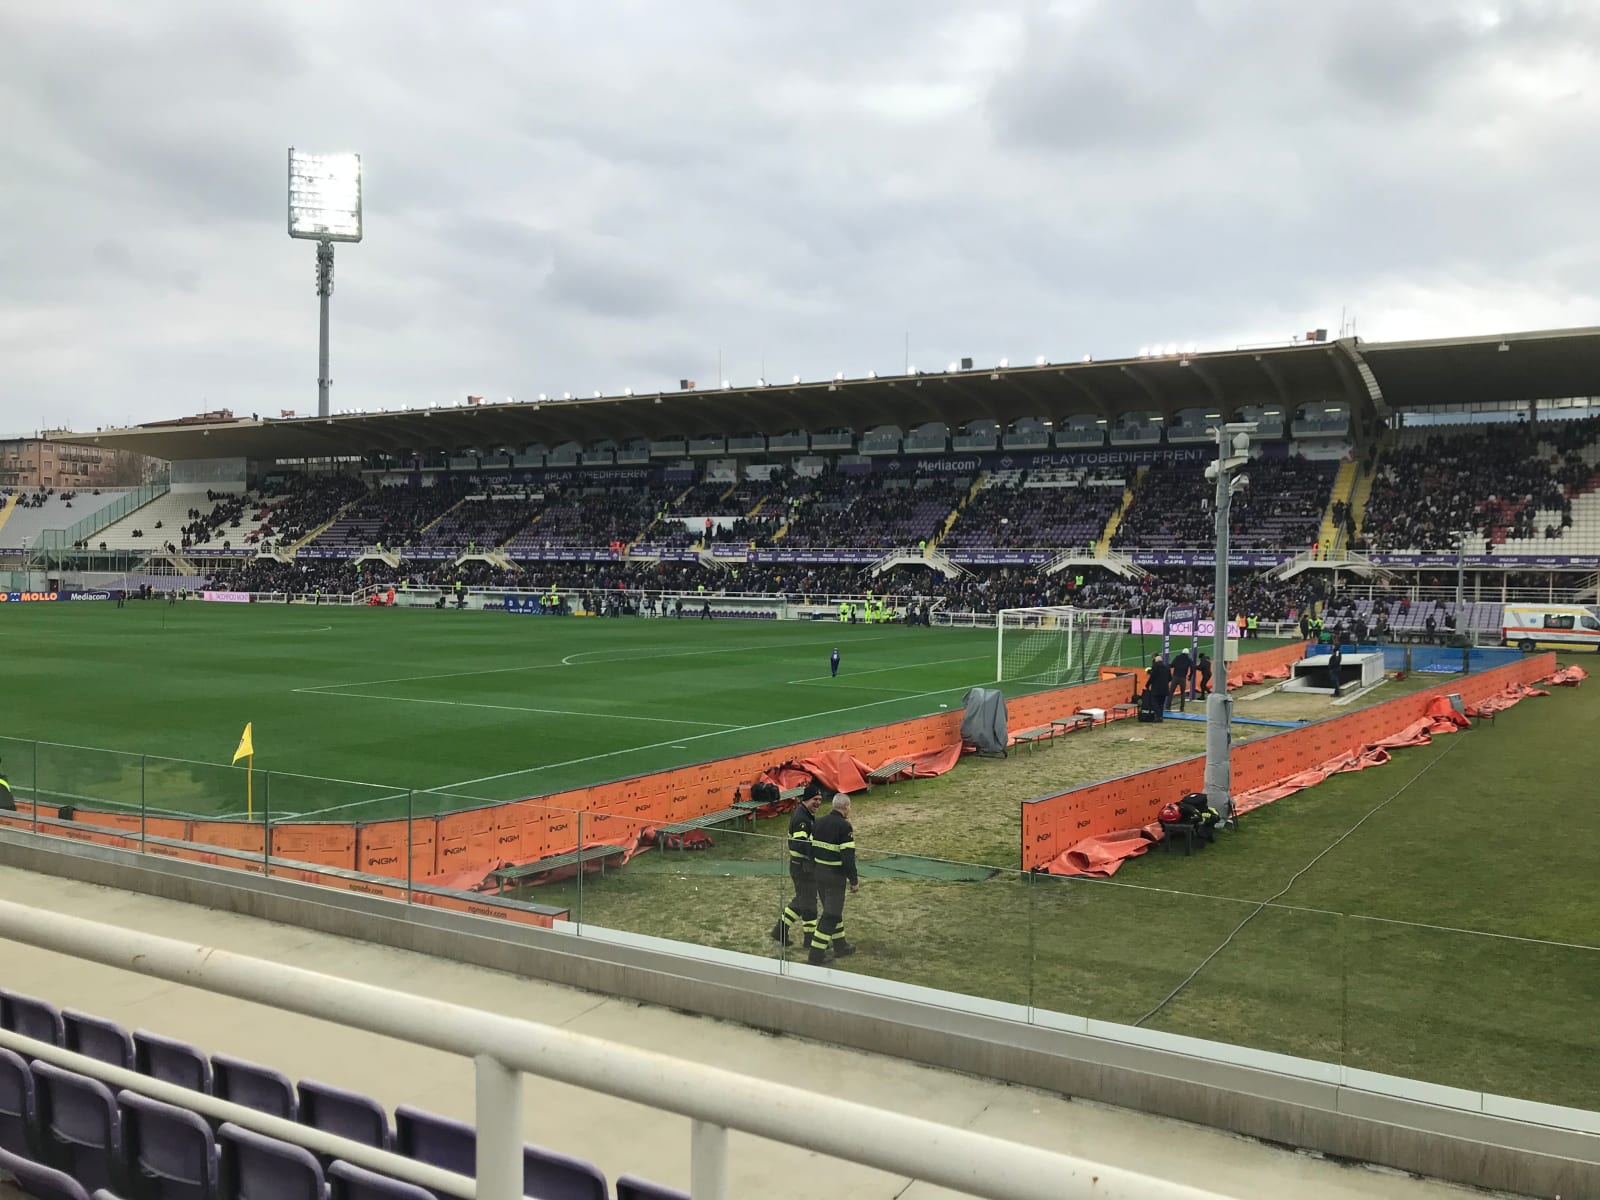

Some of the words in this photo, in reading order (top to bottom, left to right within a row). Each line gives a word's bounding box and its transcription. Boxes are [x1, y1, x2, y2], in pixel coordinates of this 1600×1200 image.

[918, 459, 976, 471] Mediacom
[21, 592, 58, 602] MOLLO
[71, 592, 108, 601] Mediacom
